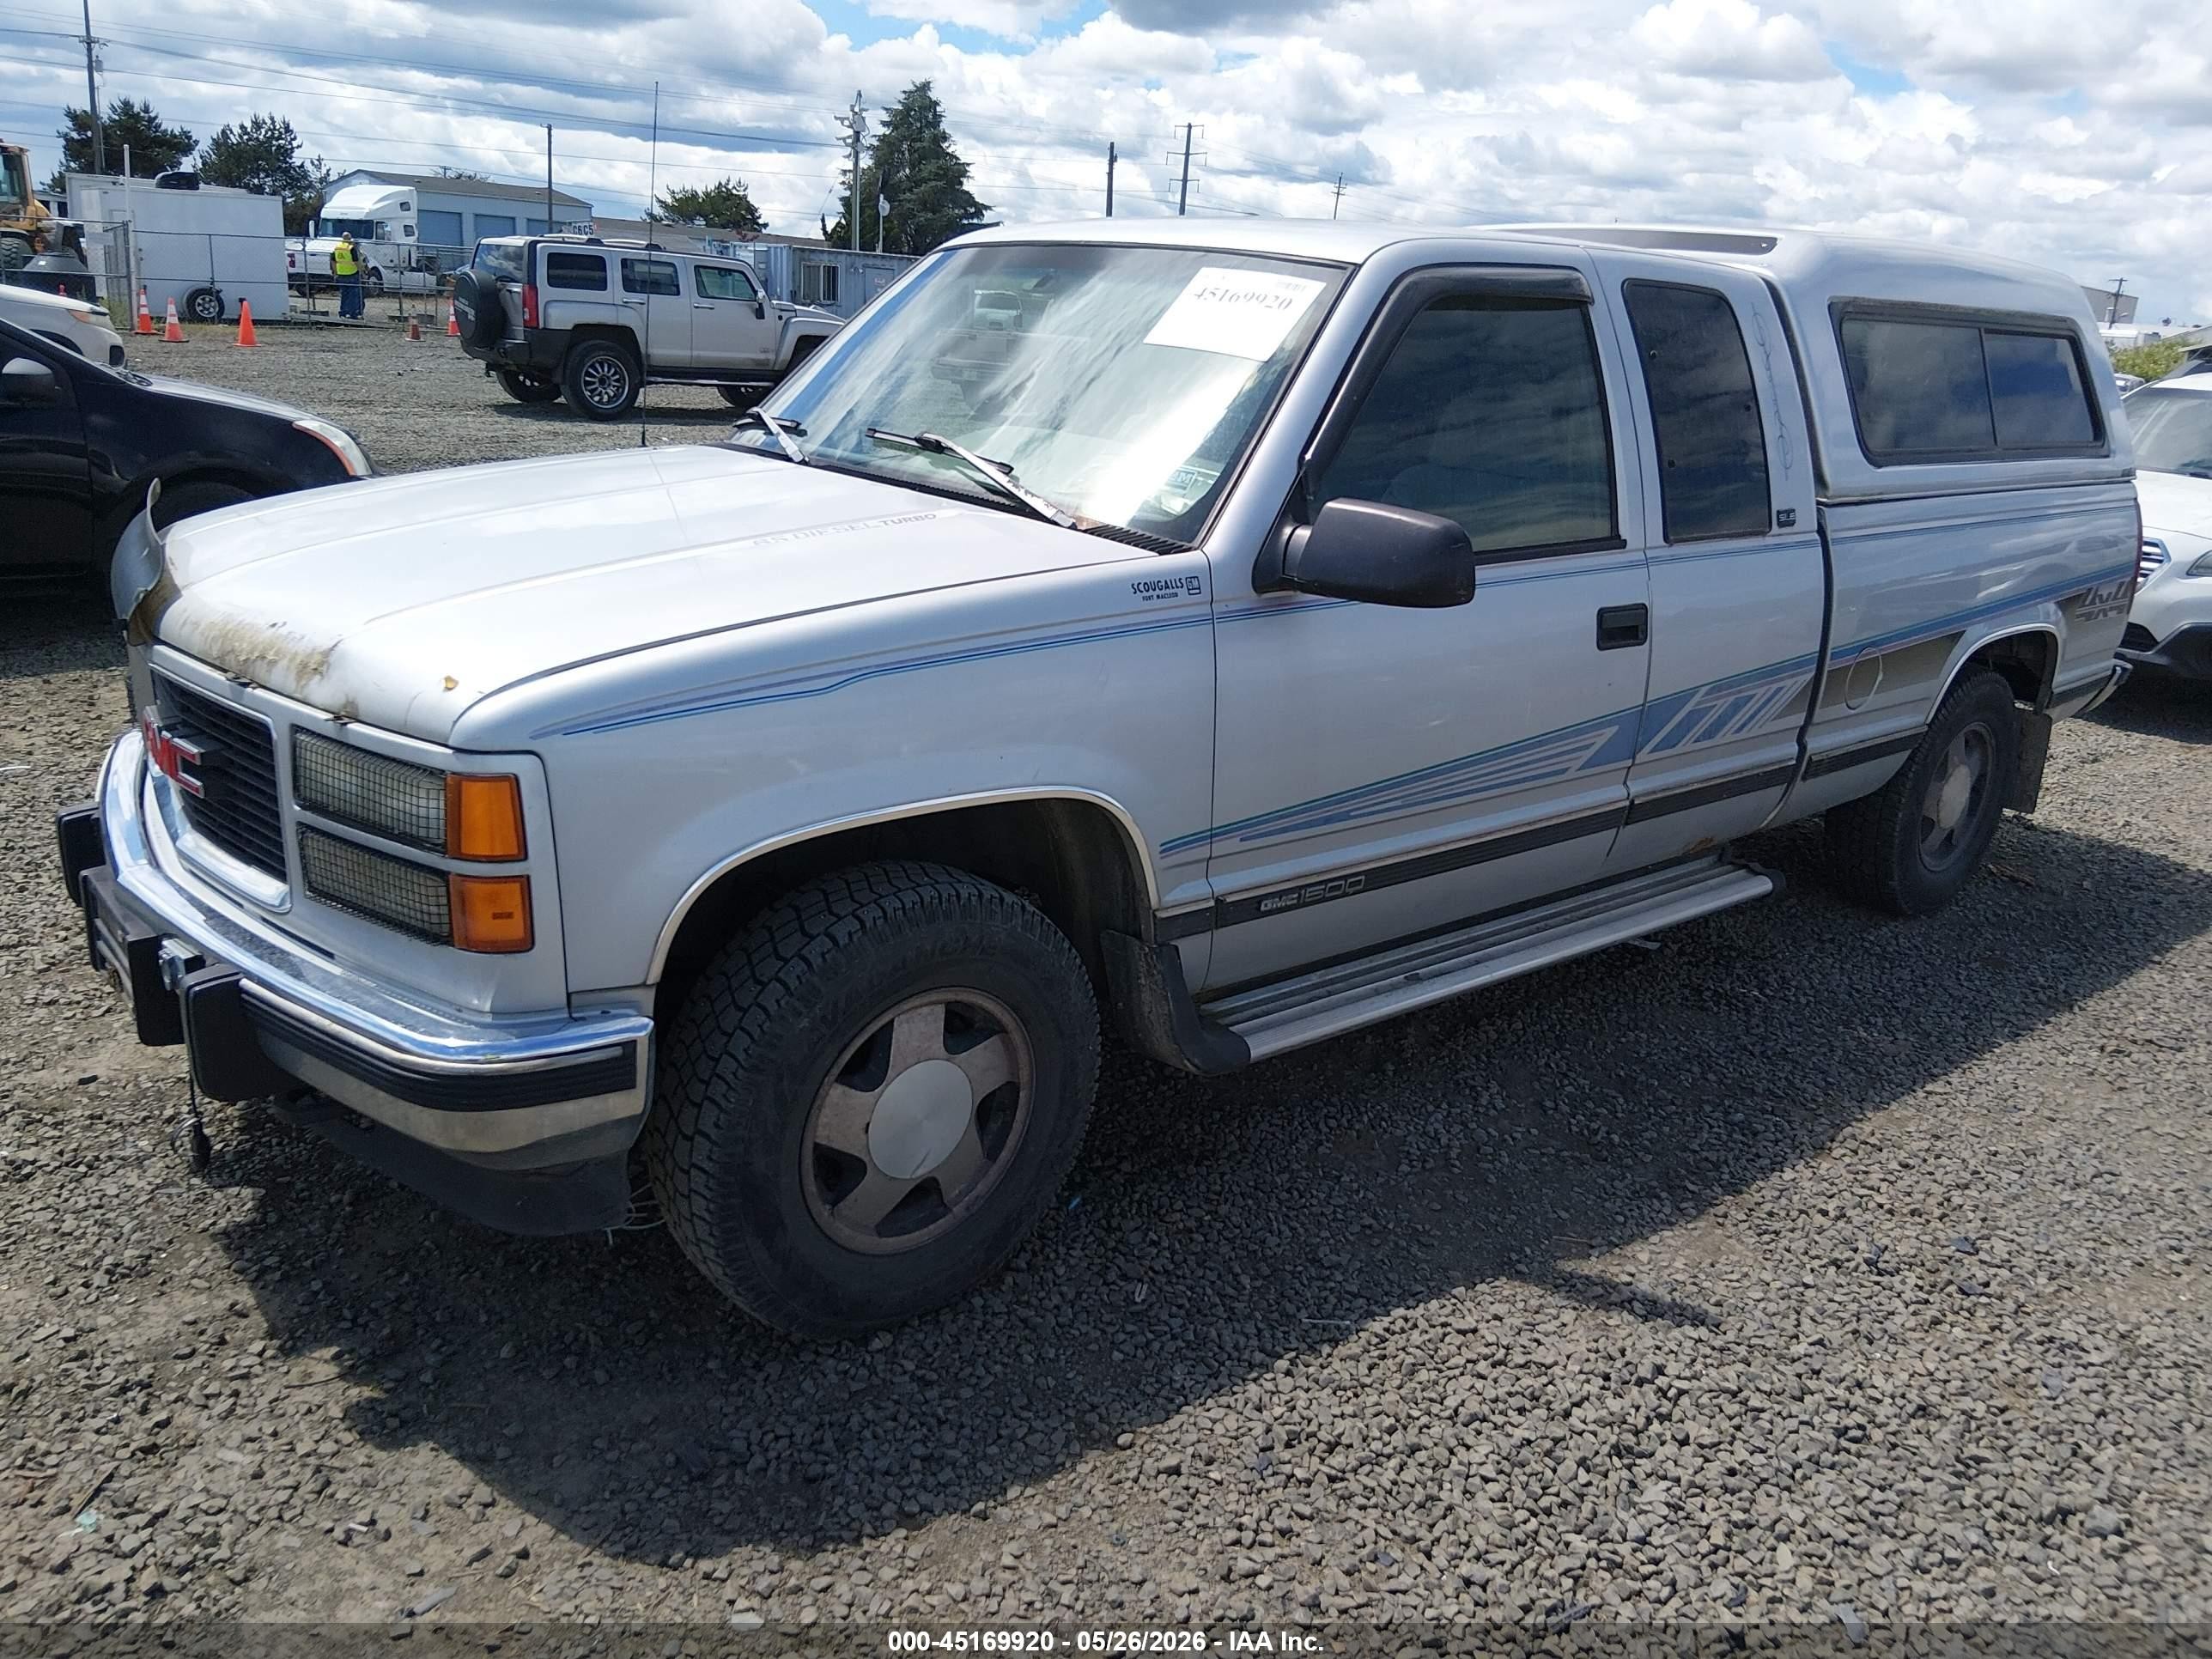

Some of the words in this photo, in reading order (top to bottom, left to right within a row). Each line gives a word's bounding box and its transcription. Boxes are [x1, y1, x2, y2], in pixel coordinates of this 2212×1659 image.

[1194, 288, 1293, 310] 45169920
[793, 522, 880, 541] DIESEL
[879, 513, 937, 527] TURBO
[1131, 577, 1184, 594] SCOUGALLS
[1260, 893, 1299, 912] GMC
[1300, 875, 1365, 902] 1500
